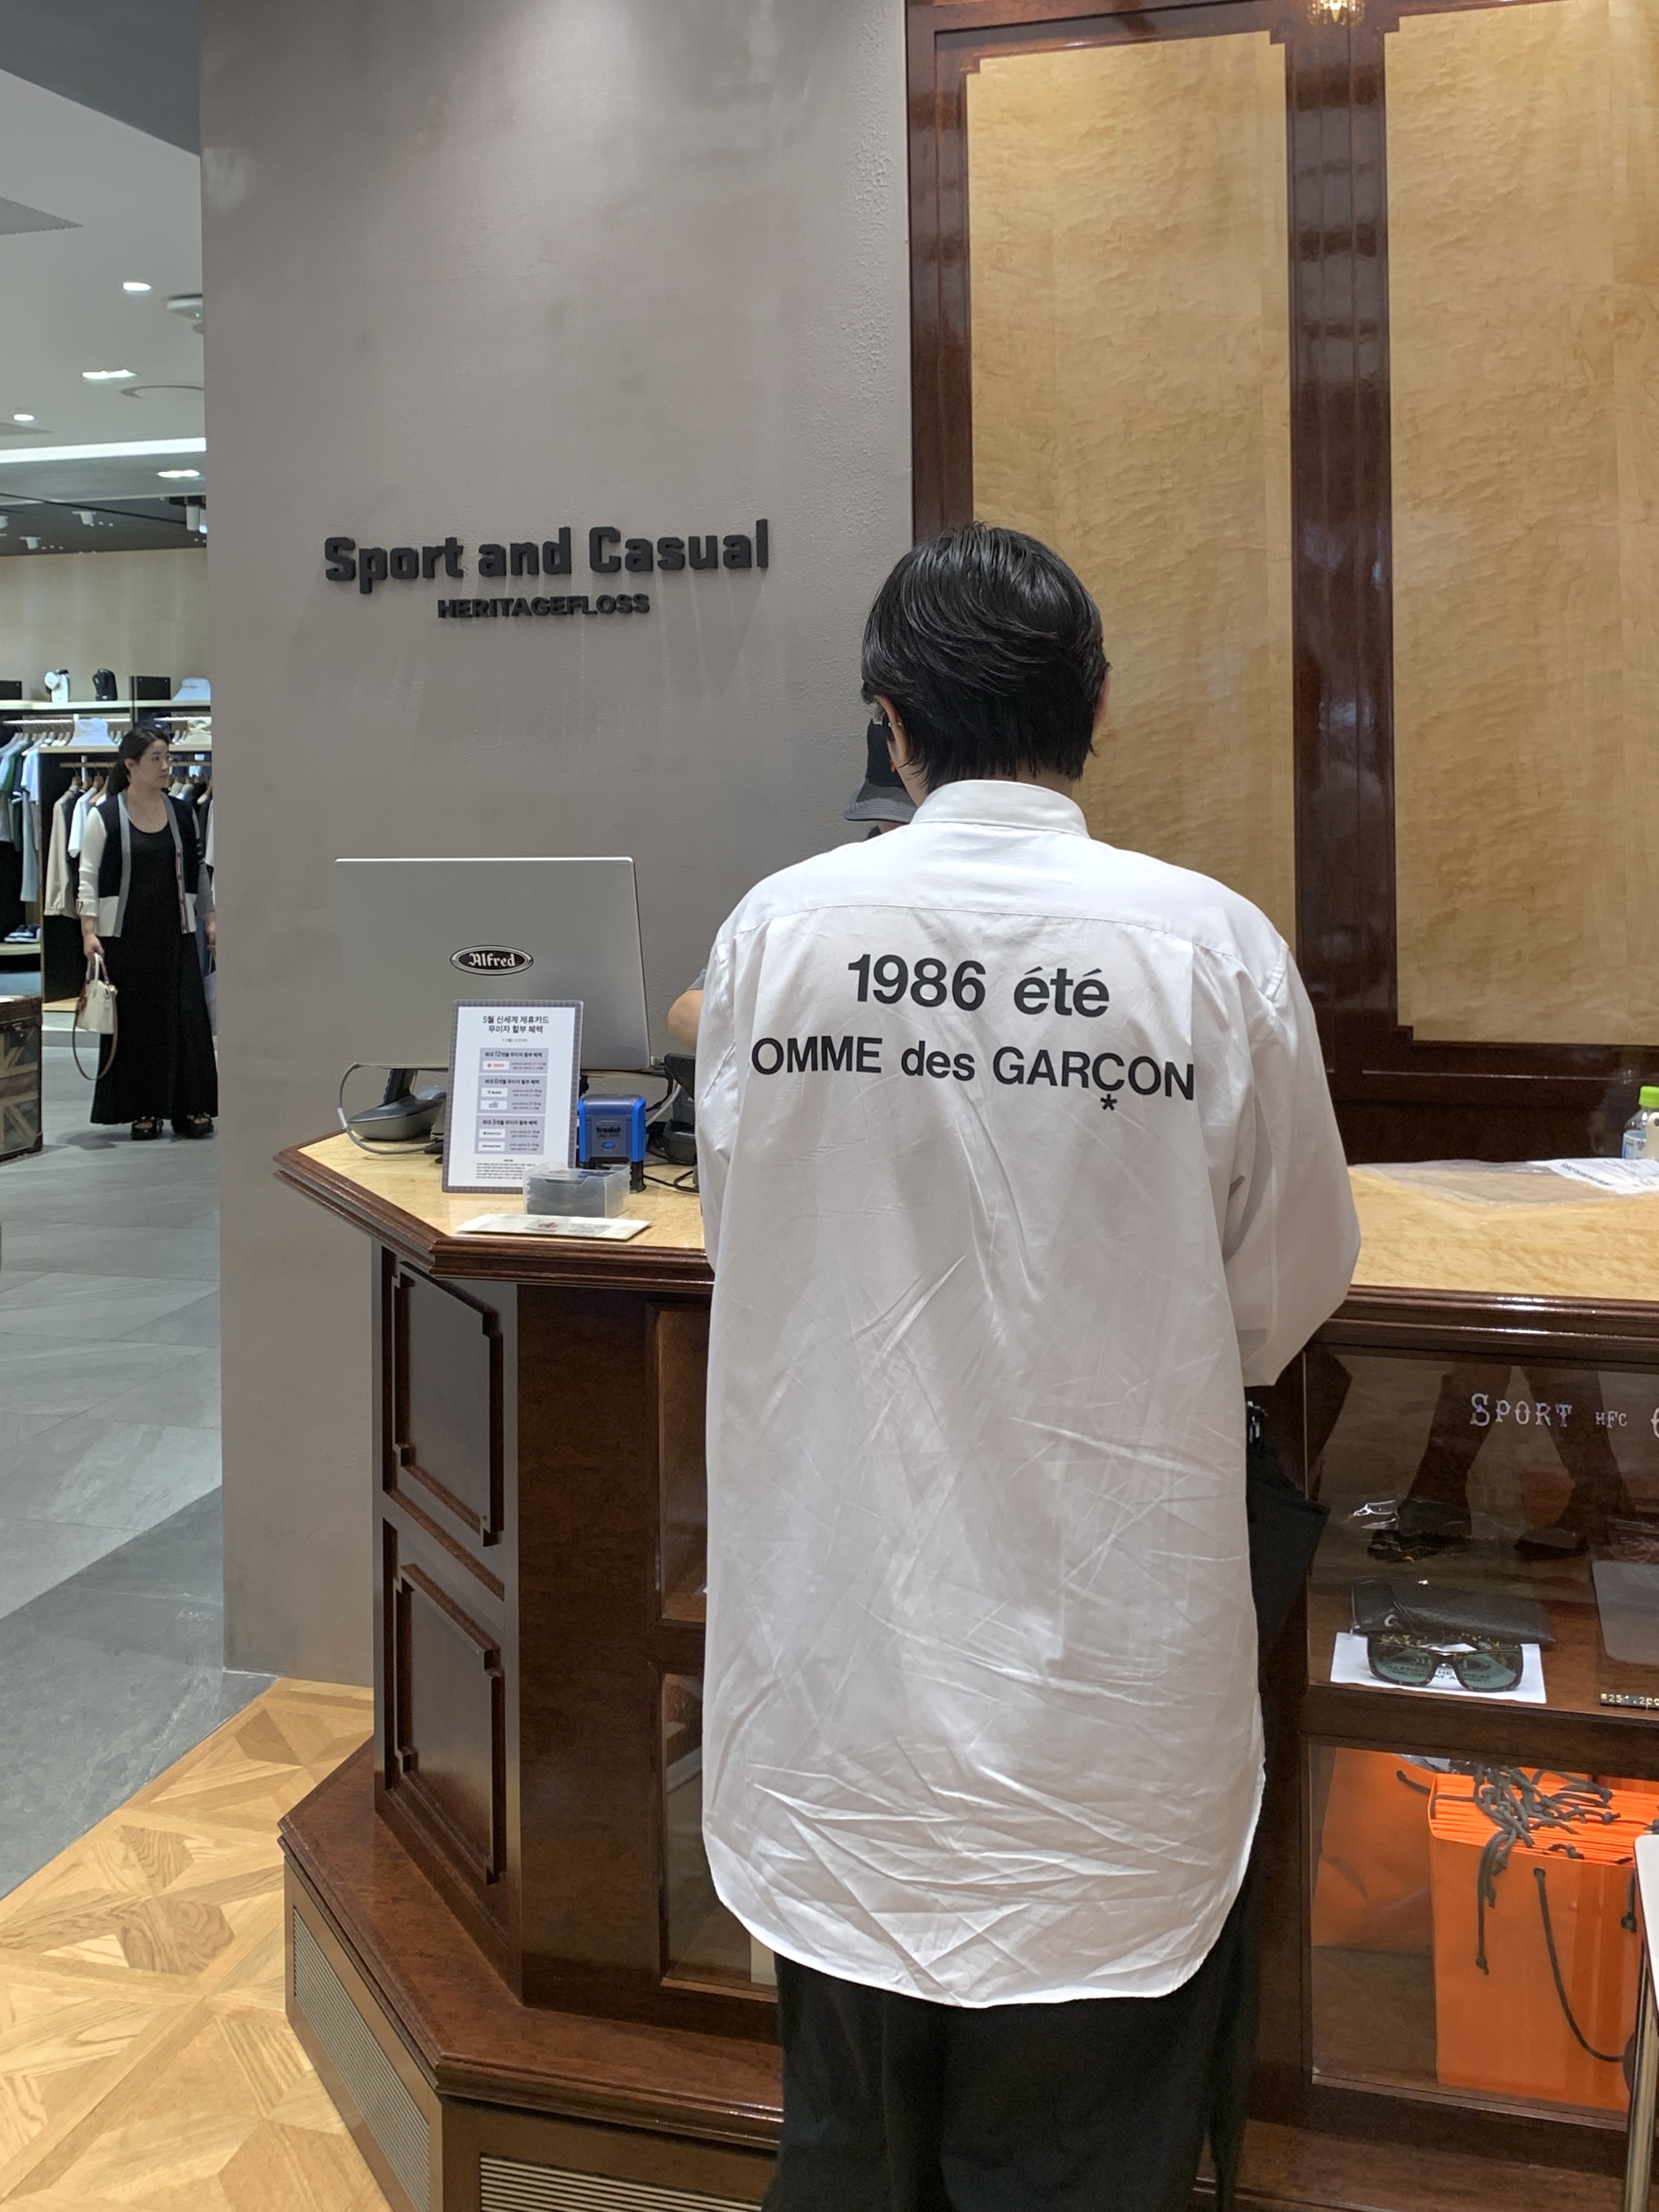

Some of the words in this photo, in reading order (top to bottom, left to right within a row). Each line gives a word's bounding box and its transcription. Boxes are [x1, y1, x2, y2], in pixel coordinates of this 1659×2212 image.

[325, 536, 464, 594] Sport
[478, 526, 571, 578] and
[589, 519, 769, 574] Casual
[438, 594, 650, 618] HERITAGEFLOSS
[468, 952, 516, 967] Alfred
[848, 953, 986, 1011] 1986
[1014, 966, 1110, 1018] été
[482, 1015, 494, 1024] 5월
[496, 1015, 519, 1024] 신세계
[520, 1015, 550, 1024] 제휴카드
[488, 1025, 510, 1033] 무이자
[512, 1025, 527, 1034] 할부
[528, 1025, 543, 1034] 혜택
[901, 1040, 975, 1081] des
[1595, 1410, 1627, 1428] HFC
